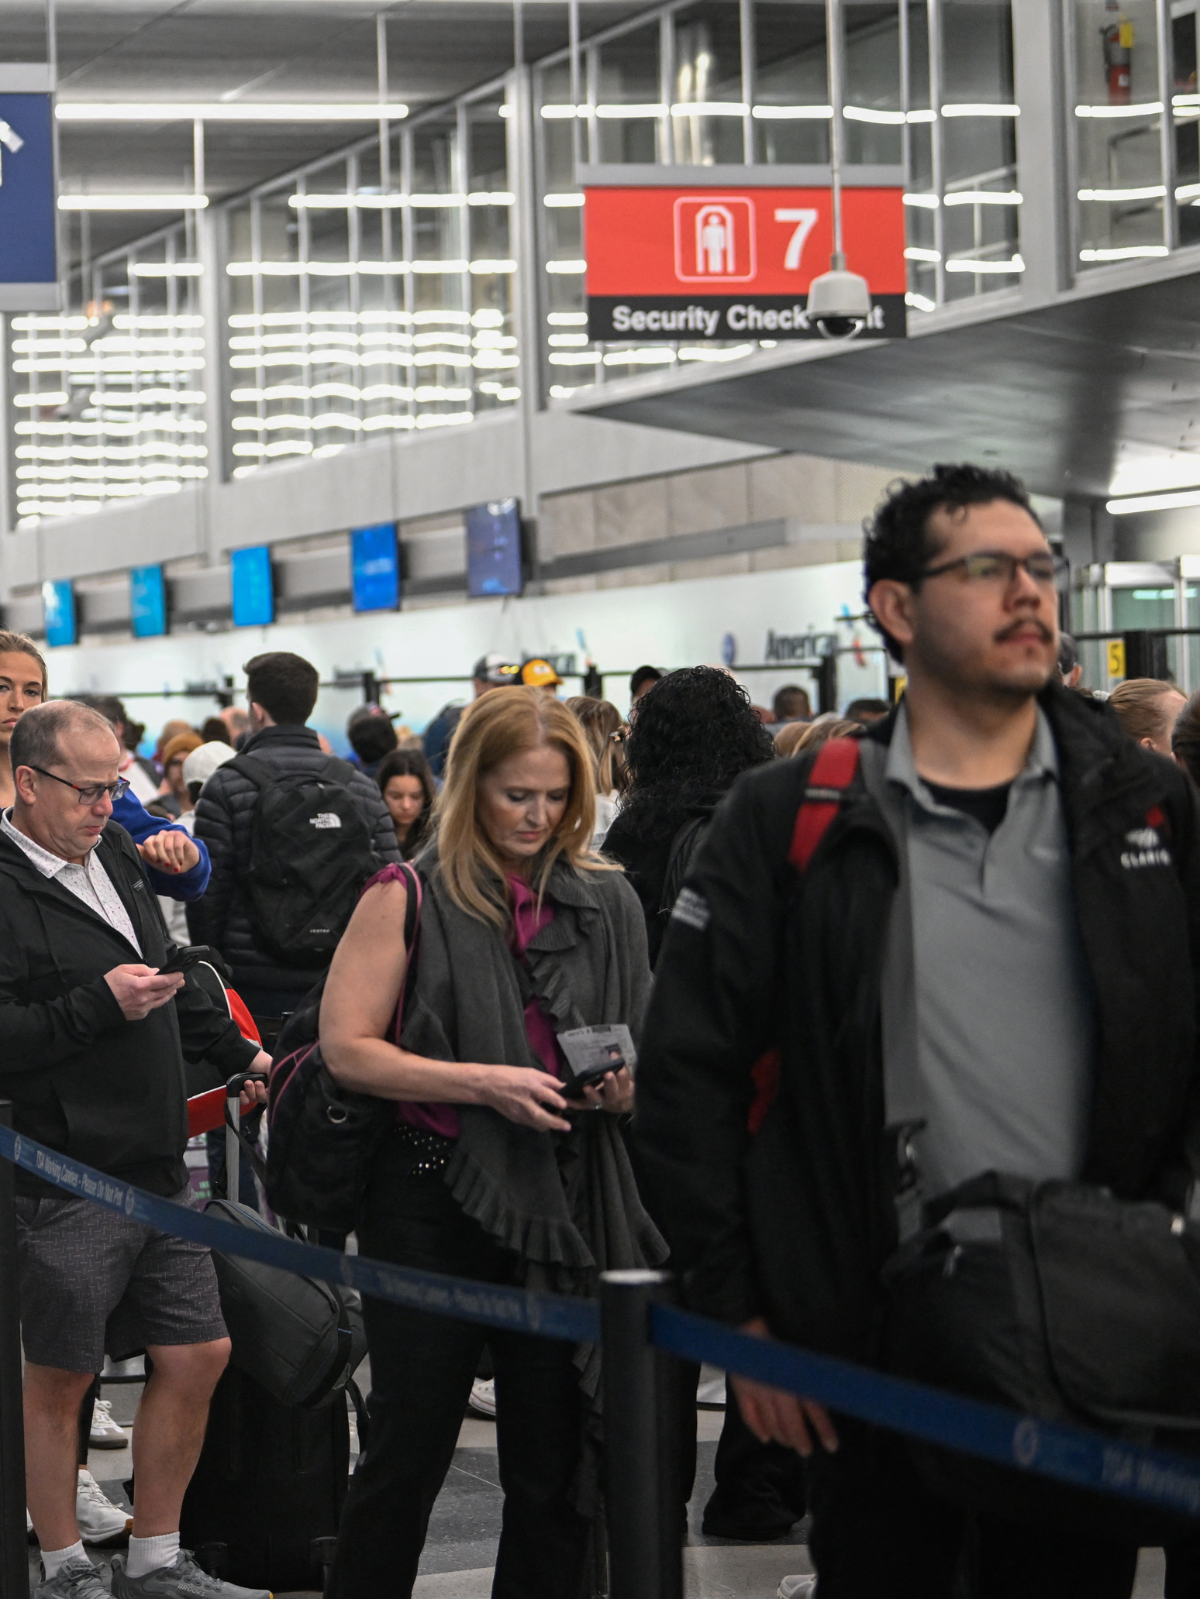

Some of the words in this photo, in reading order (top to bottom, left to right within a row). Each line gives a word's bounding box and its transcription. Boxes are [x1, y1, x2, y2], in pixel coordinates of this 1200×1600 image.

[774, 208, 818, 270] 7
[612, 305, 720, 336] Security
[726, 304, 885, 331] Checkt
[178, 1584, 206, 1597] BROOKS
